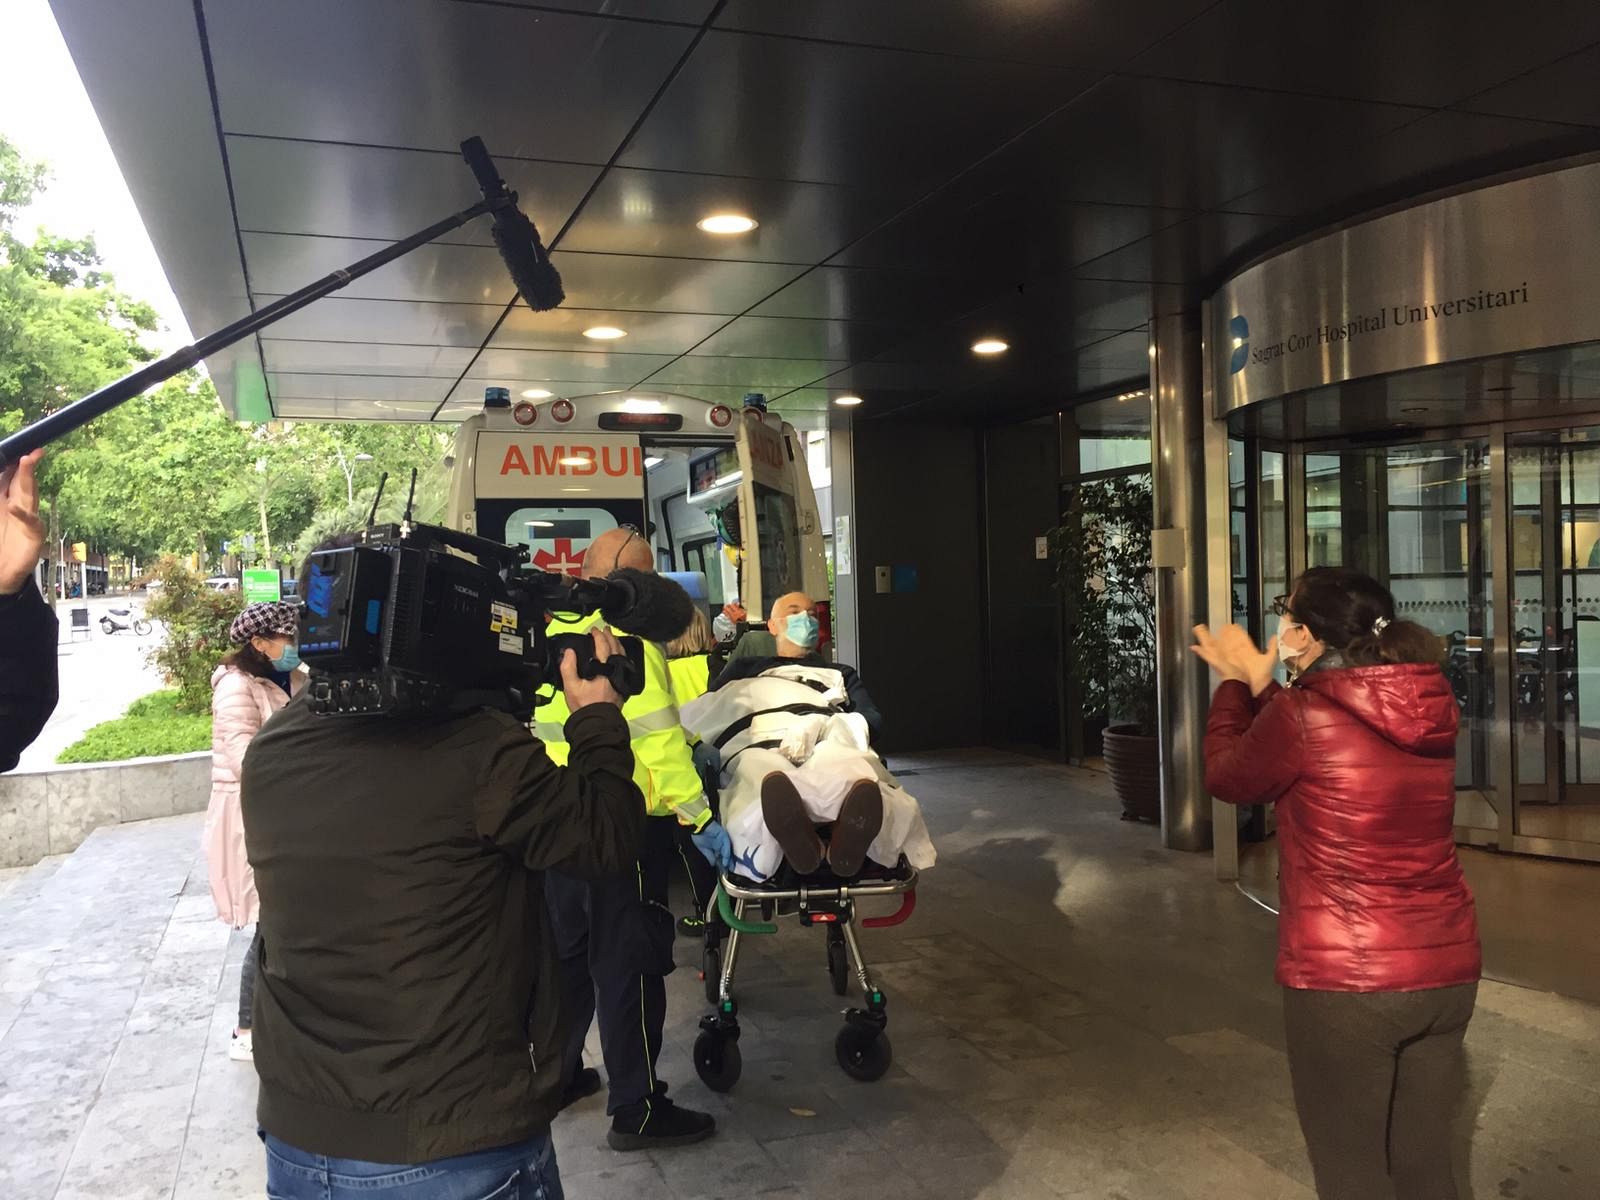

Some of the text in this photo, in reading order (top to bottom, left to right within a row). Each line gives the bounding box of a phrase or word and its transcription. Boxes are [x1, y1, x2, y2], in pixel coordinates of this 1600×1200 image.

[1252, 281, 1529, 365] Sagrat Cor Hospital Universitari
